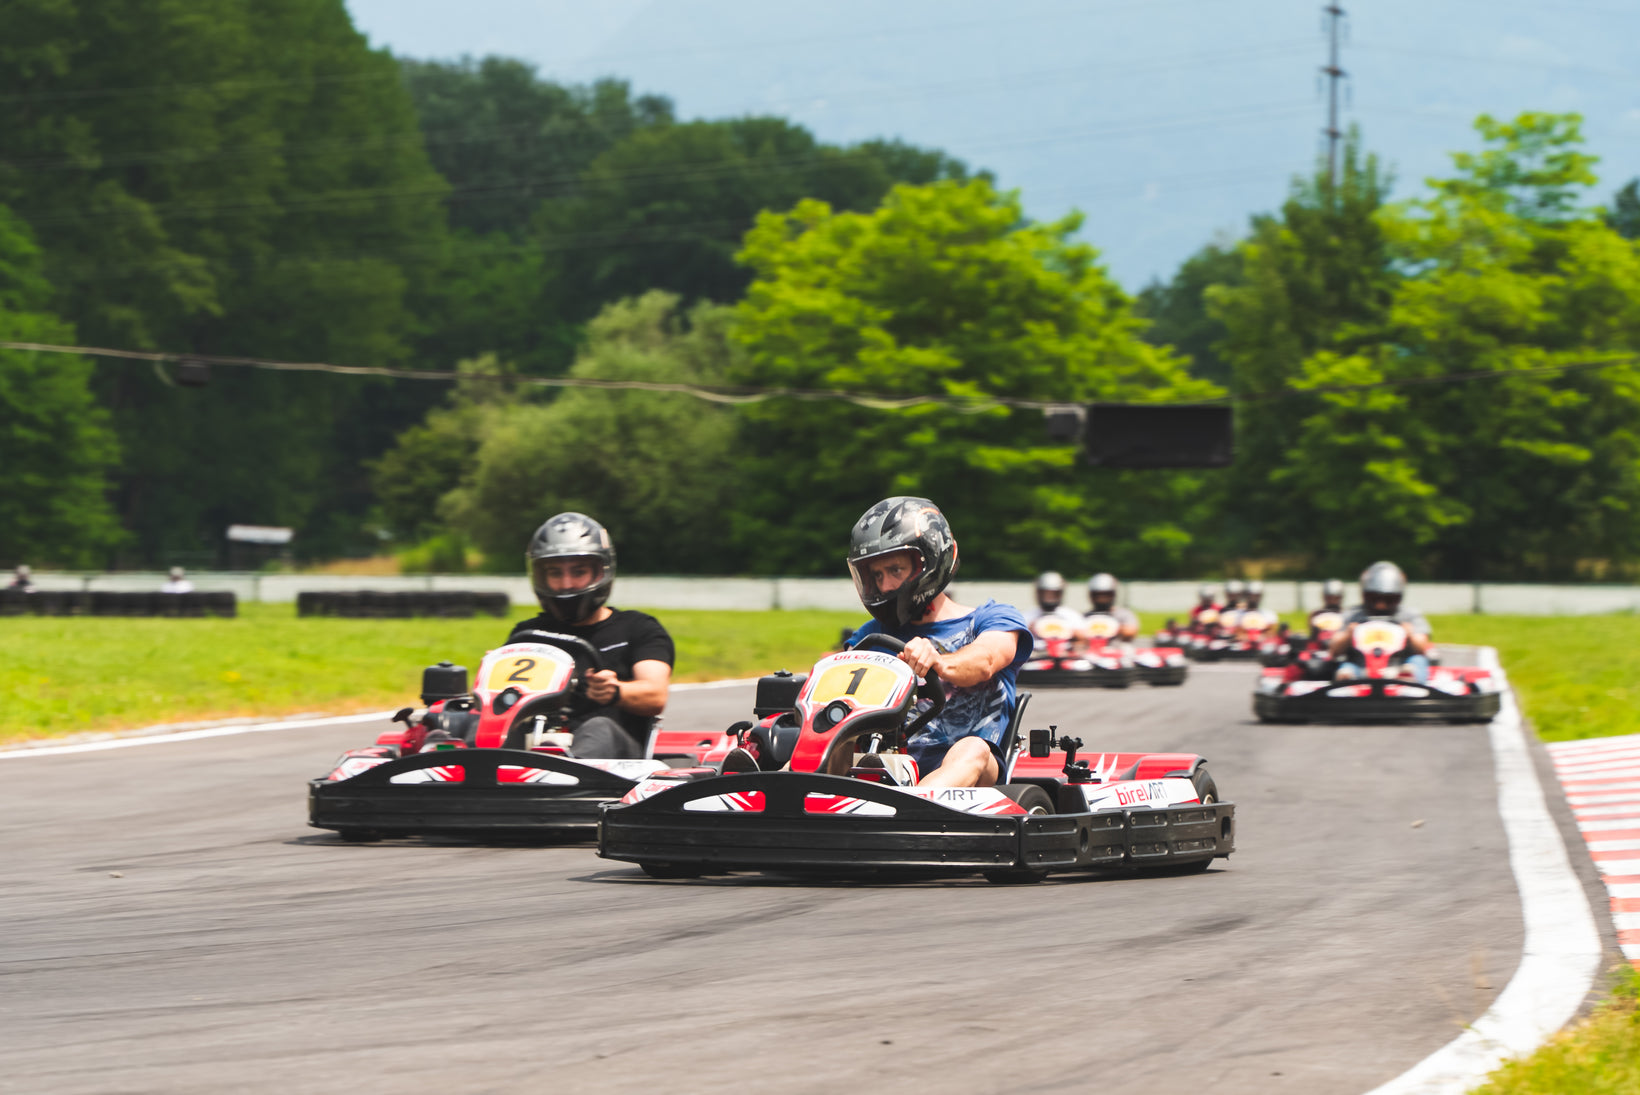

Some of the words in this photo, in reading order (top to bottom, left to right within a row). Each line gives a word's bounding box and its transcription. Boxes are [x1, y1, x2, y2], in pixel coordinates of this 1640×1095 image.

[508, 659, 536, 682] 2
[845, 668, 868, 695] 1
[1115, 781, 1168, 806] birelART
